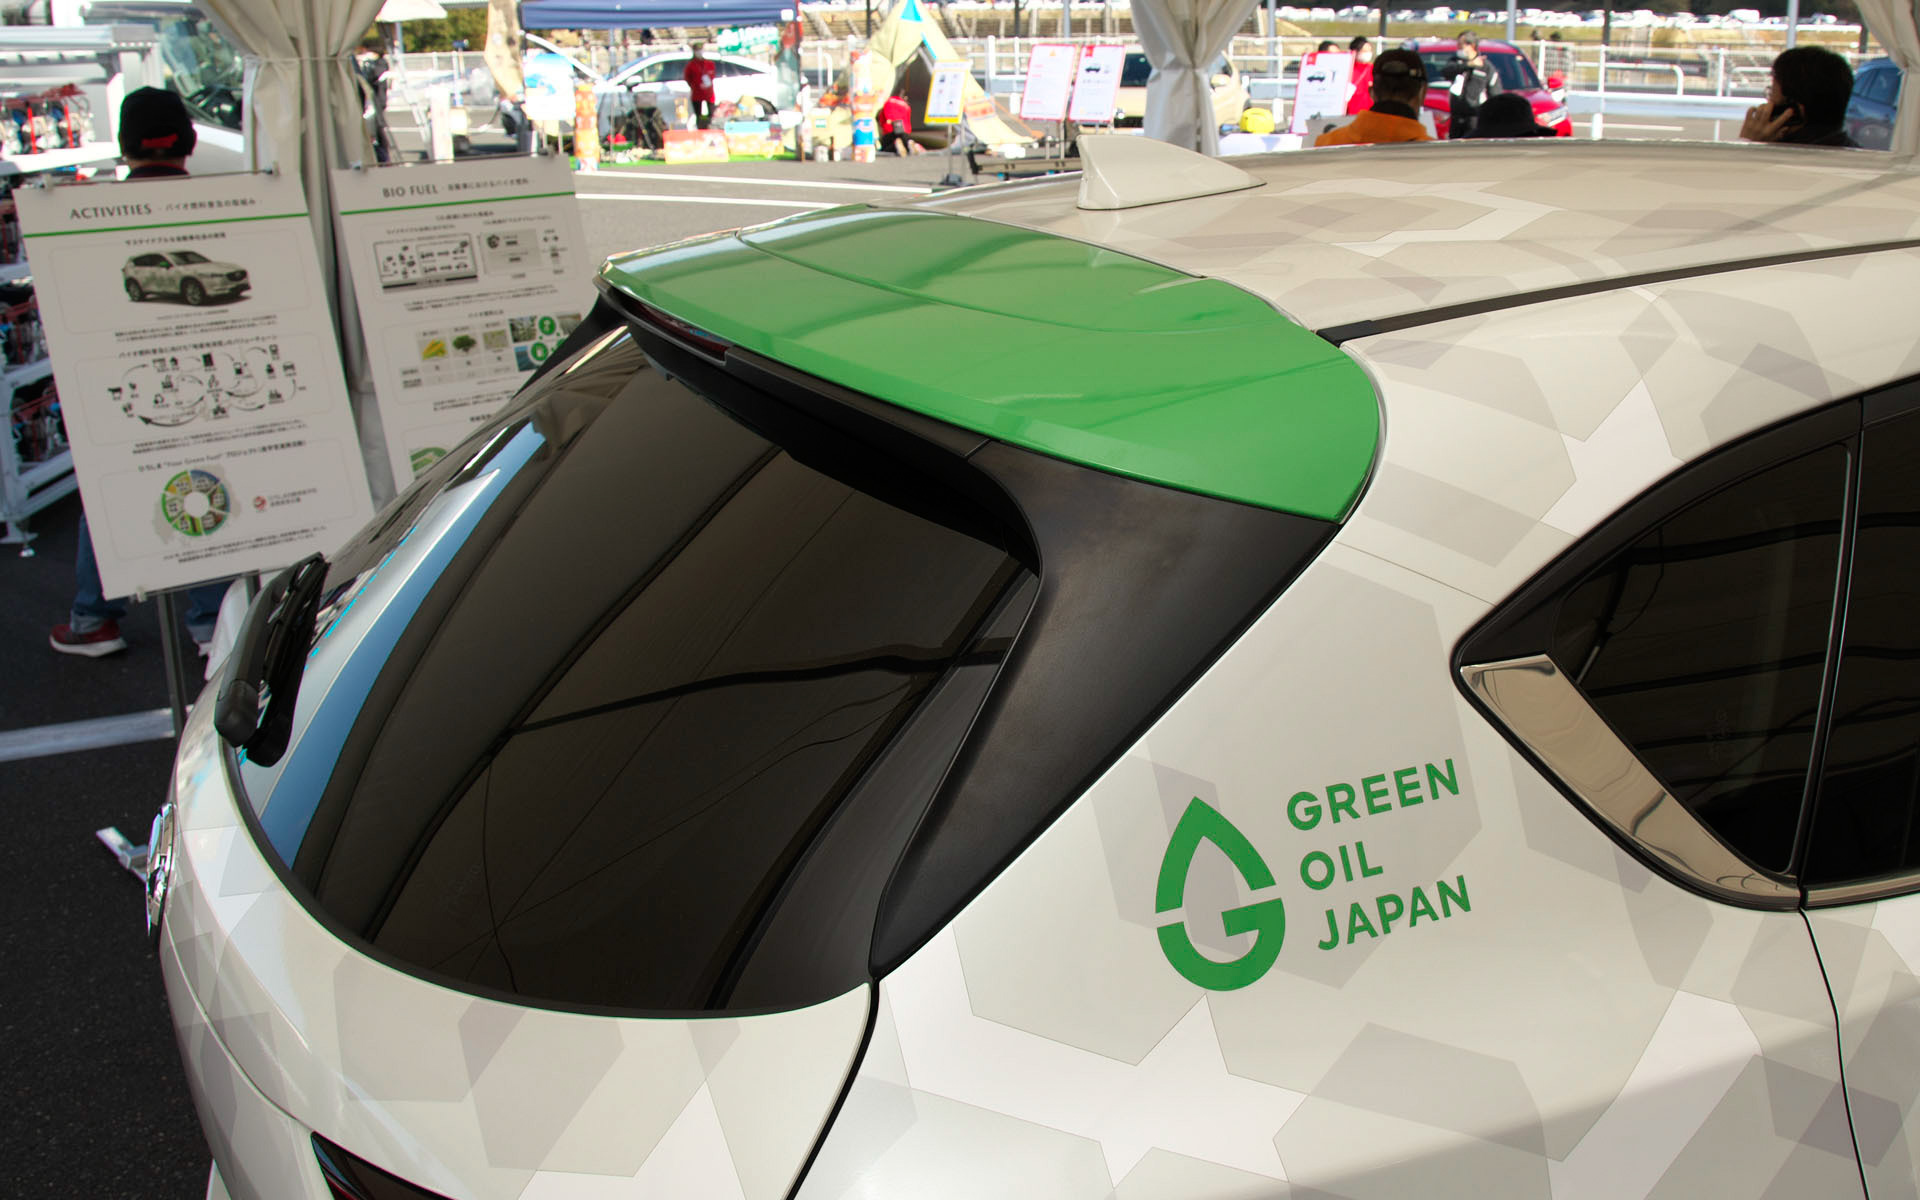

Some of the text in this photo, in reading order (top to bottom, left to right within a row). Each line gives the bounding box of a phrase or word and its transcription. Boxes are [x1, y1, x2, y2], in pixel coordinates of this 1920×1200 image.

[70, 203, 152, 219] ACTIVITIES
[382, 186, 405, 198] BIO
[410, 183, 438, 196] FUEL
[1287, 758, 1460, 831] GREEN
[1300, 841, 1384, 891] OIL
[1318, 875, 1472, 951] JAPAN
